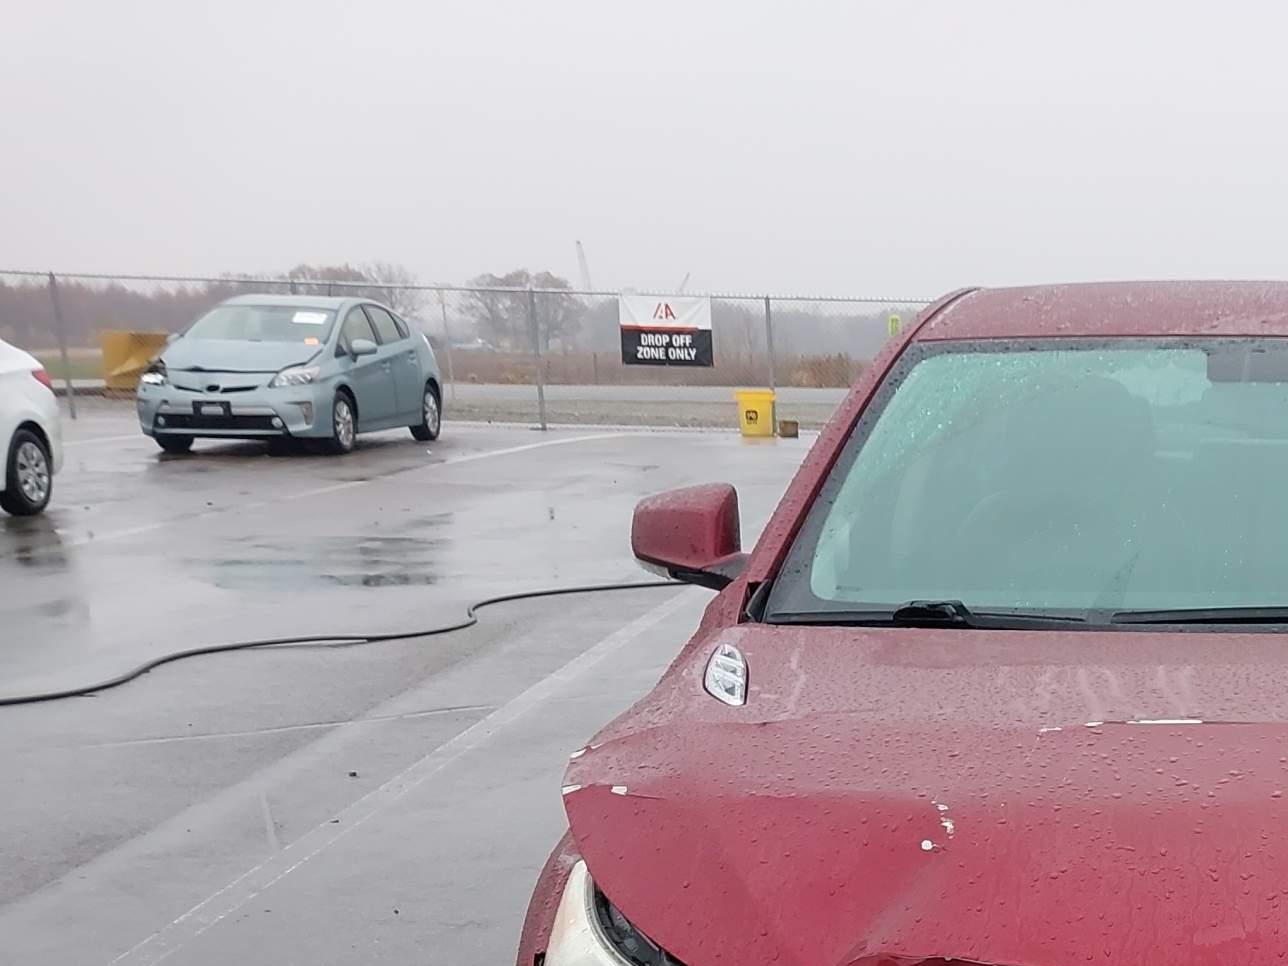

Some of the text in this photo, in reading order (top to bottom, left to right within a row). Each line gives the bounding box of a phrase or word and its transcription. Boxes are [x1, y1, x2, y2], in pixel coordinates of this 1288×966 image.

[640, 333, 692, 347] DROP OFF
[636, 346, 696, 360] ZONE ONLY
